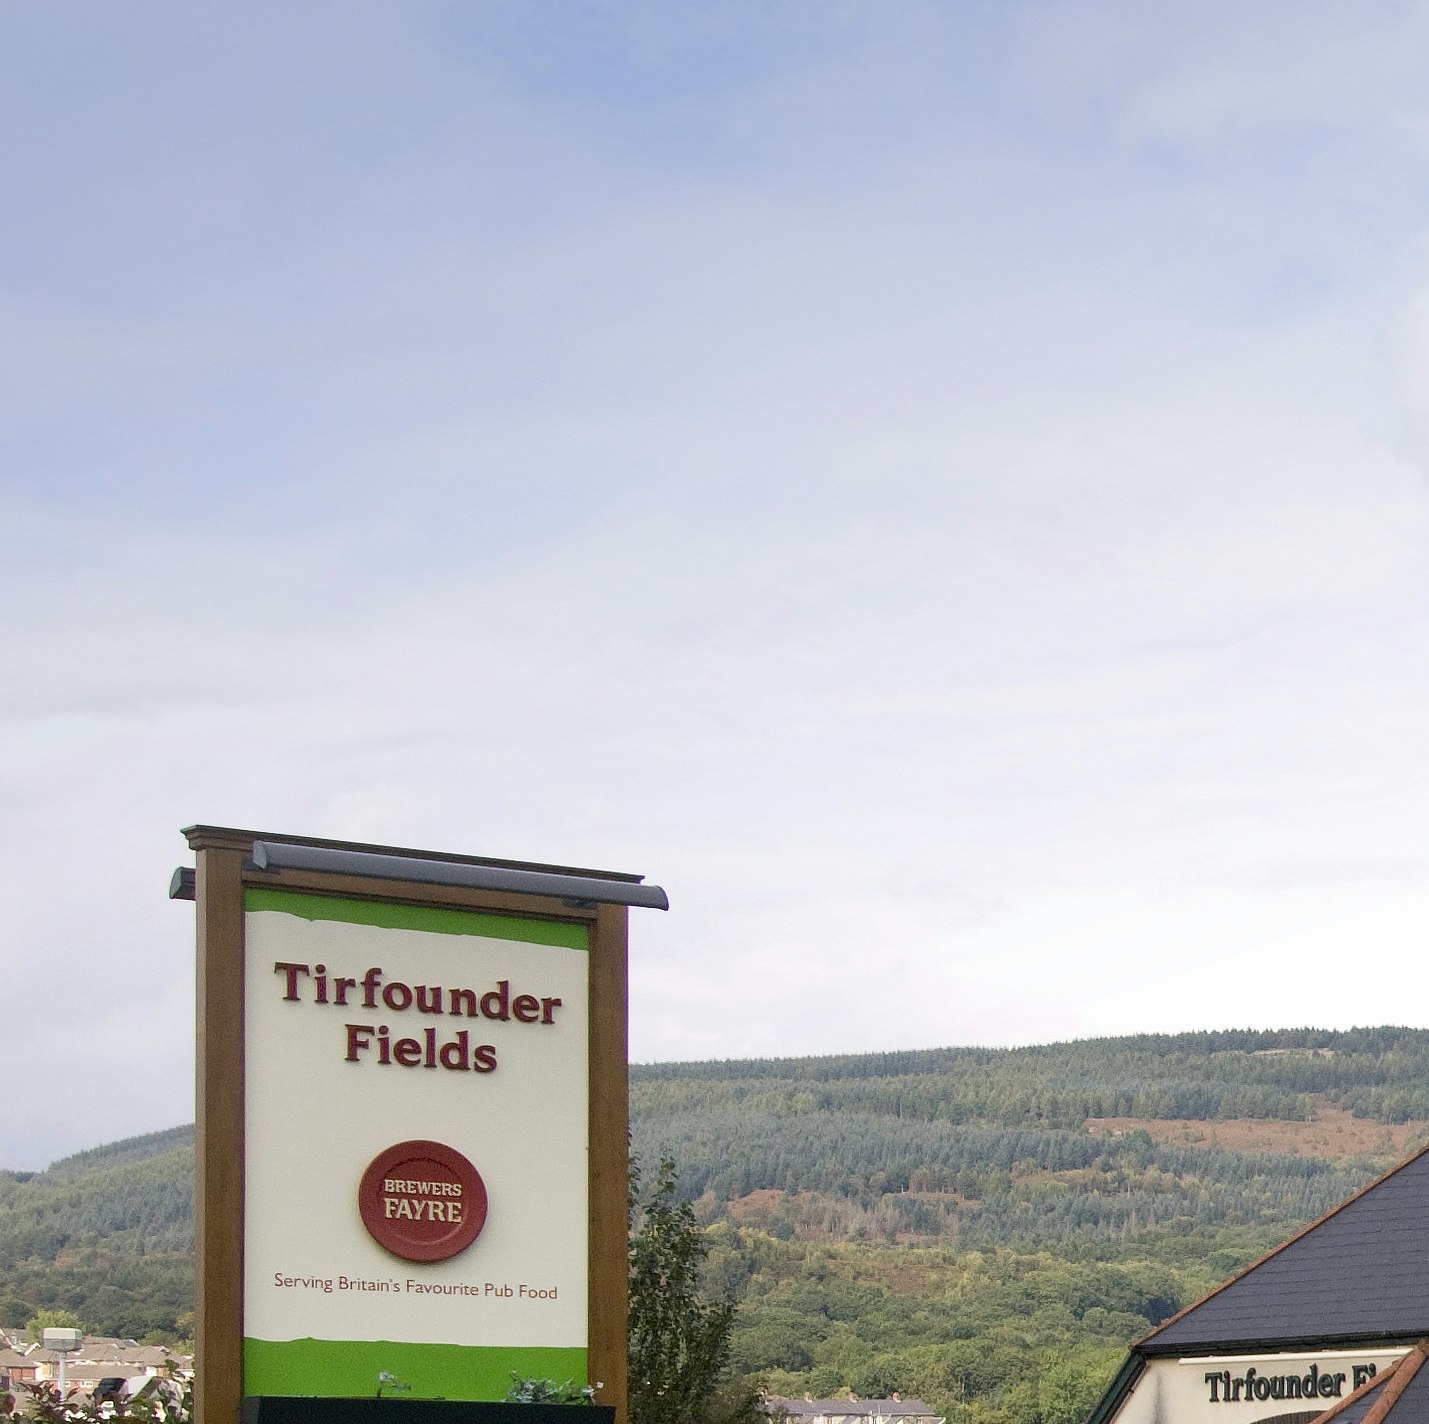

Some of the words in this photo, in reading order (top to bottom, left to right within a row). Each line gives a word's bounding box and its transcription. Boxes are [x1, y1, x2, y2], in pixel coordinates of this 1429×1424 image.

[274, 961, 562, 1025] Tirfounder
[344, 1023, 498, 1073] Fields
[383, 1179, 462, 1197] BREWERS
[383, 1197, 462, 1223] FAYRE
[274, 1272, 333, 1293] Serving
[338, 1275, 401, 1293] Britain's
[405, 1279, 479, 1296] Favourite
[484, 1282, 514, 1298] Pub
[518, 1284, 558, 1300] Food
[1204, 1363, 1346, 1403] Tirfounder
